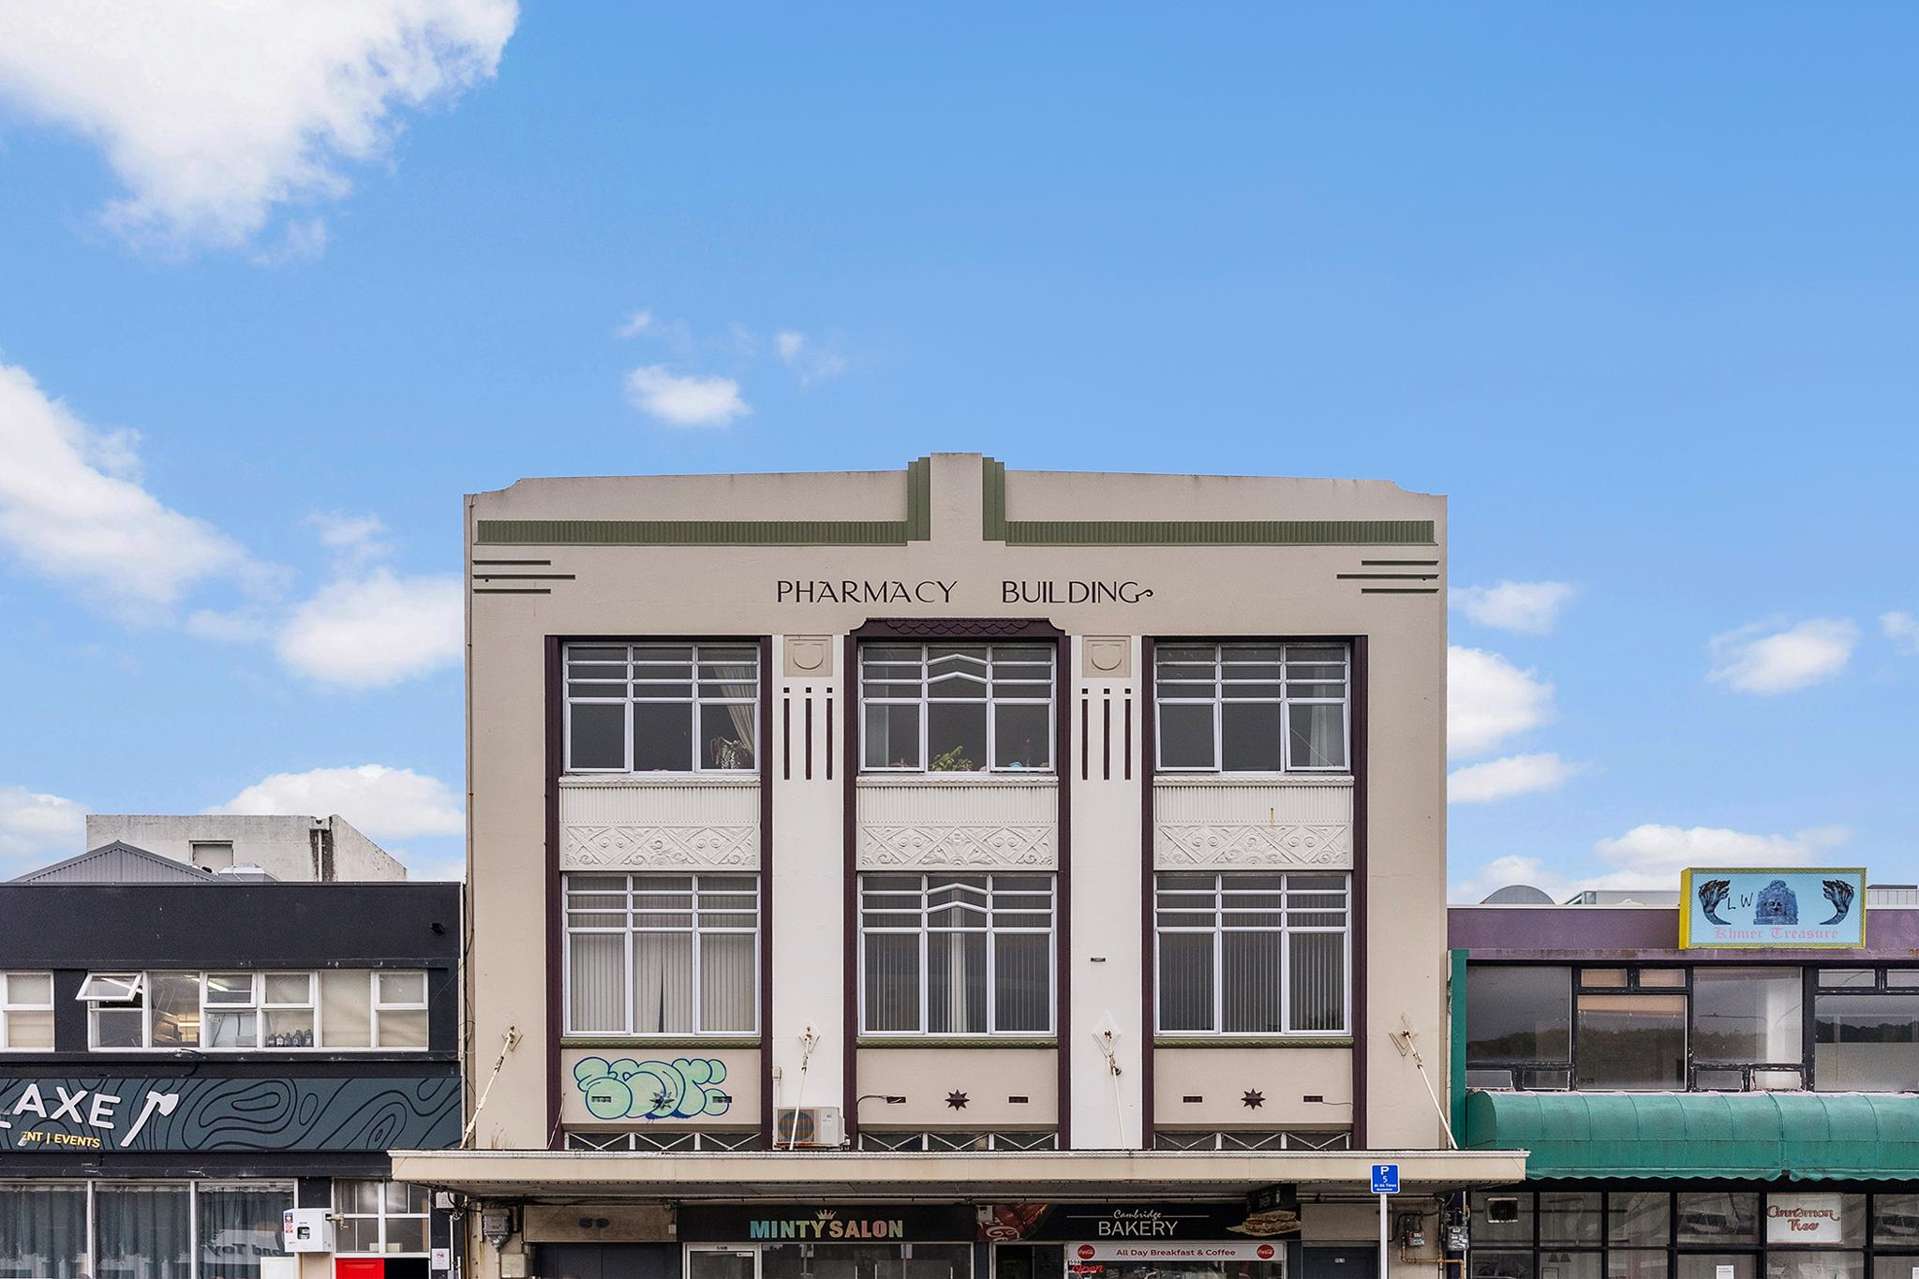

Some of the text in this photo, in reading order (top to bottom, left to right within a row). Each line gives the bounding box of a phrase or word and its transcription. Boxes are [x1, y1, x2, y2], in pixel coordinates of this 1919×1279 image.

[776, 580, 1153, 604] PHARMACY BUILDING
[1770, 926, 1840, 940] Treasure
[54, 1133, 101, 1148] EVENTS
[1380, 1166, 1389, 1175] P
[1113, 1209, 1162, 1220] Cambridge
[750, 1220, 904, 1238] MINTY SALON
[1098, 1220, 1179, 1236] BAKERY
[1131, 1249, 1148, 1258] Day
[1151, 1248, 1195, 1257] Breakfast
[1206, 1248, 1236, 1256] Coffee
